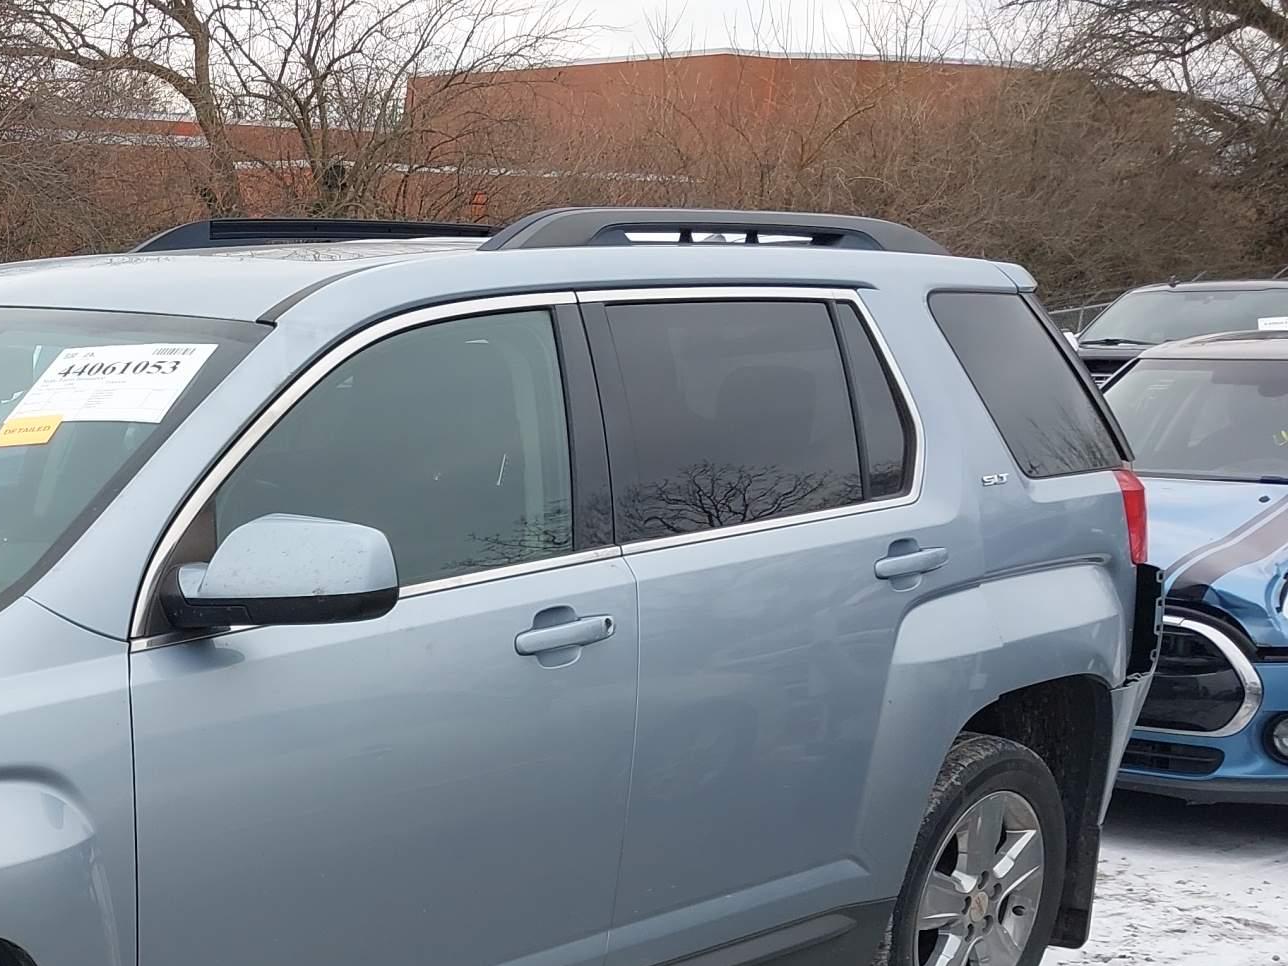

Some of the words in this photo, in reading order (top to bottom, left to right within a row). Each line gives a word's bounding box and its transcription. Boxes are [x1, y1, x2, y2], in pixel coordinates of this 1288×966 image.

[57, 360, 181, 378] 44061053
[3, 424, 53, 436] DETAILED
[981, 473, 1009, 487] SLT
